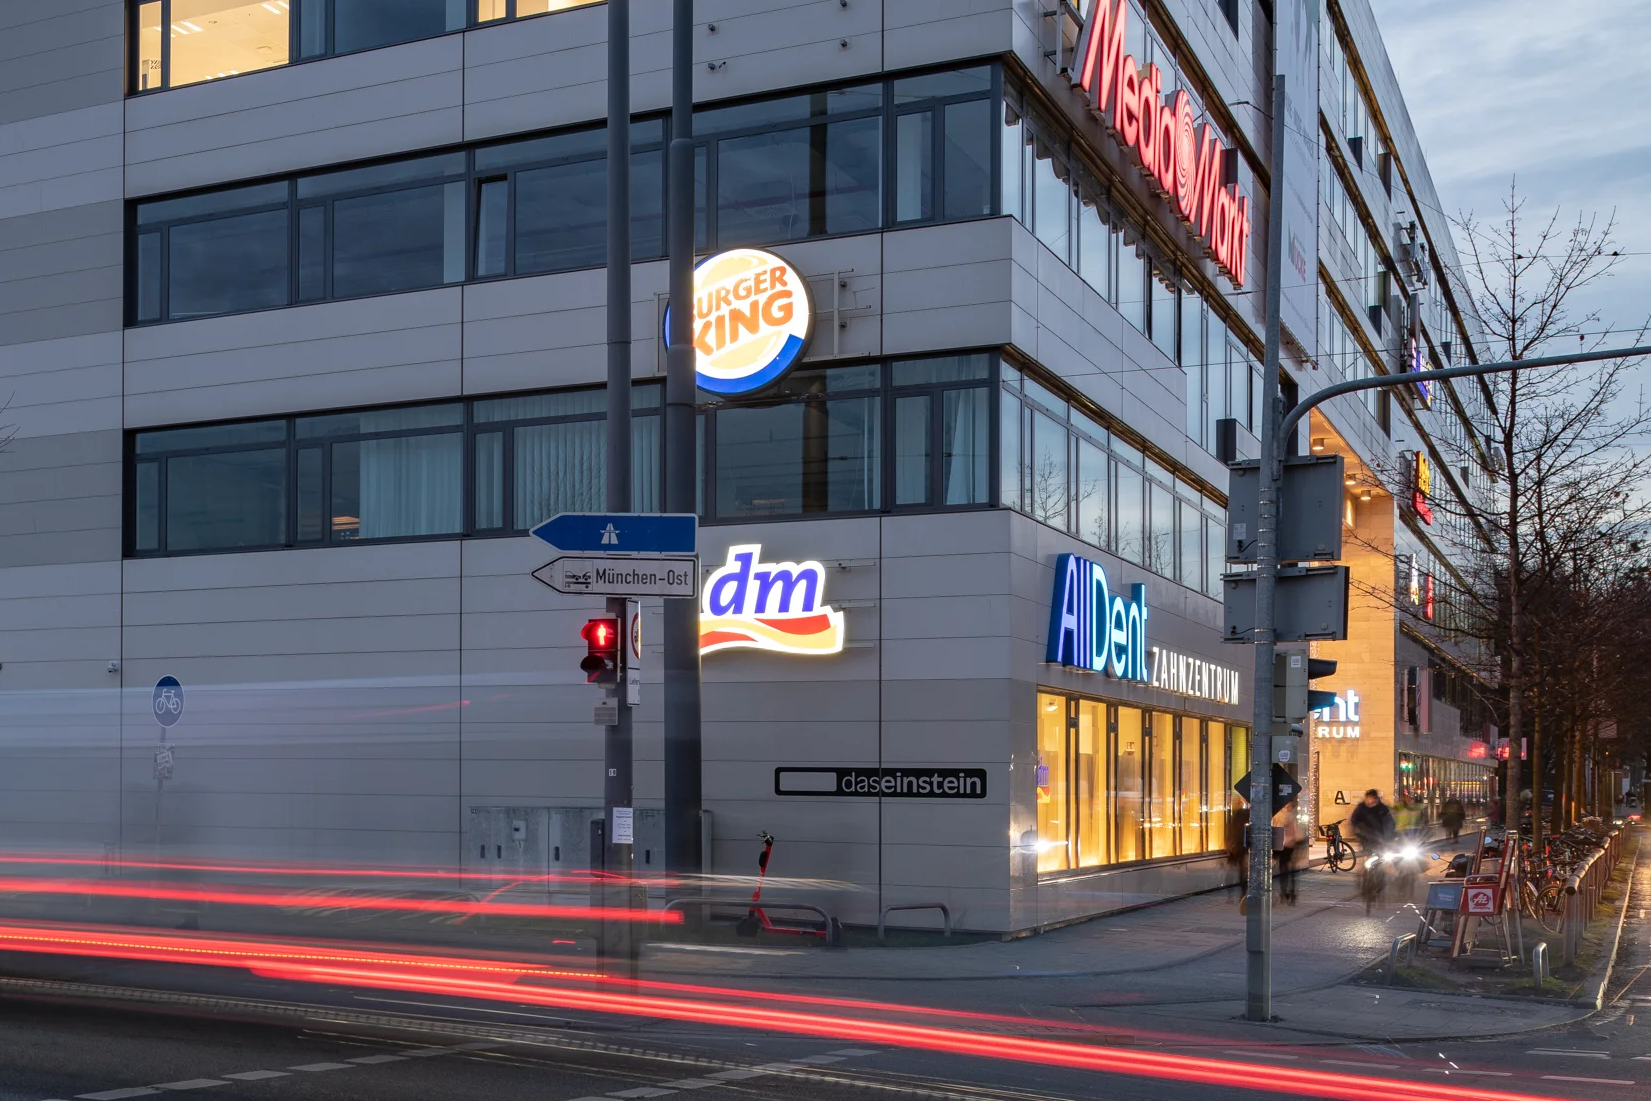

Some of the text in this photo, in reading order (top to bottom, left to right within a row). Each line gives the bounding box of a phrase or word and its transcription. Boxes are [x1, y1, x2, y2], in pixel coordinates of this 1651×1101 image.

[595, 567, 689, 586] München-Ost
[709, 551, 819, 617] dm
[1057, 554, 1148, 683] AllDent
[1152, 646, 1239, 706] ZAHNZENTRUM
[841, 772, 982, 794] daseinstein
